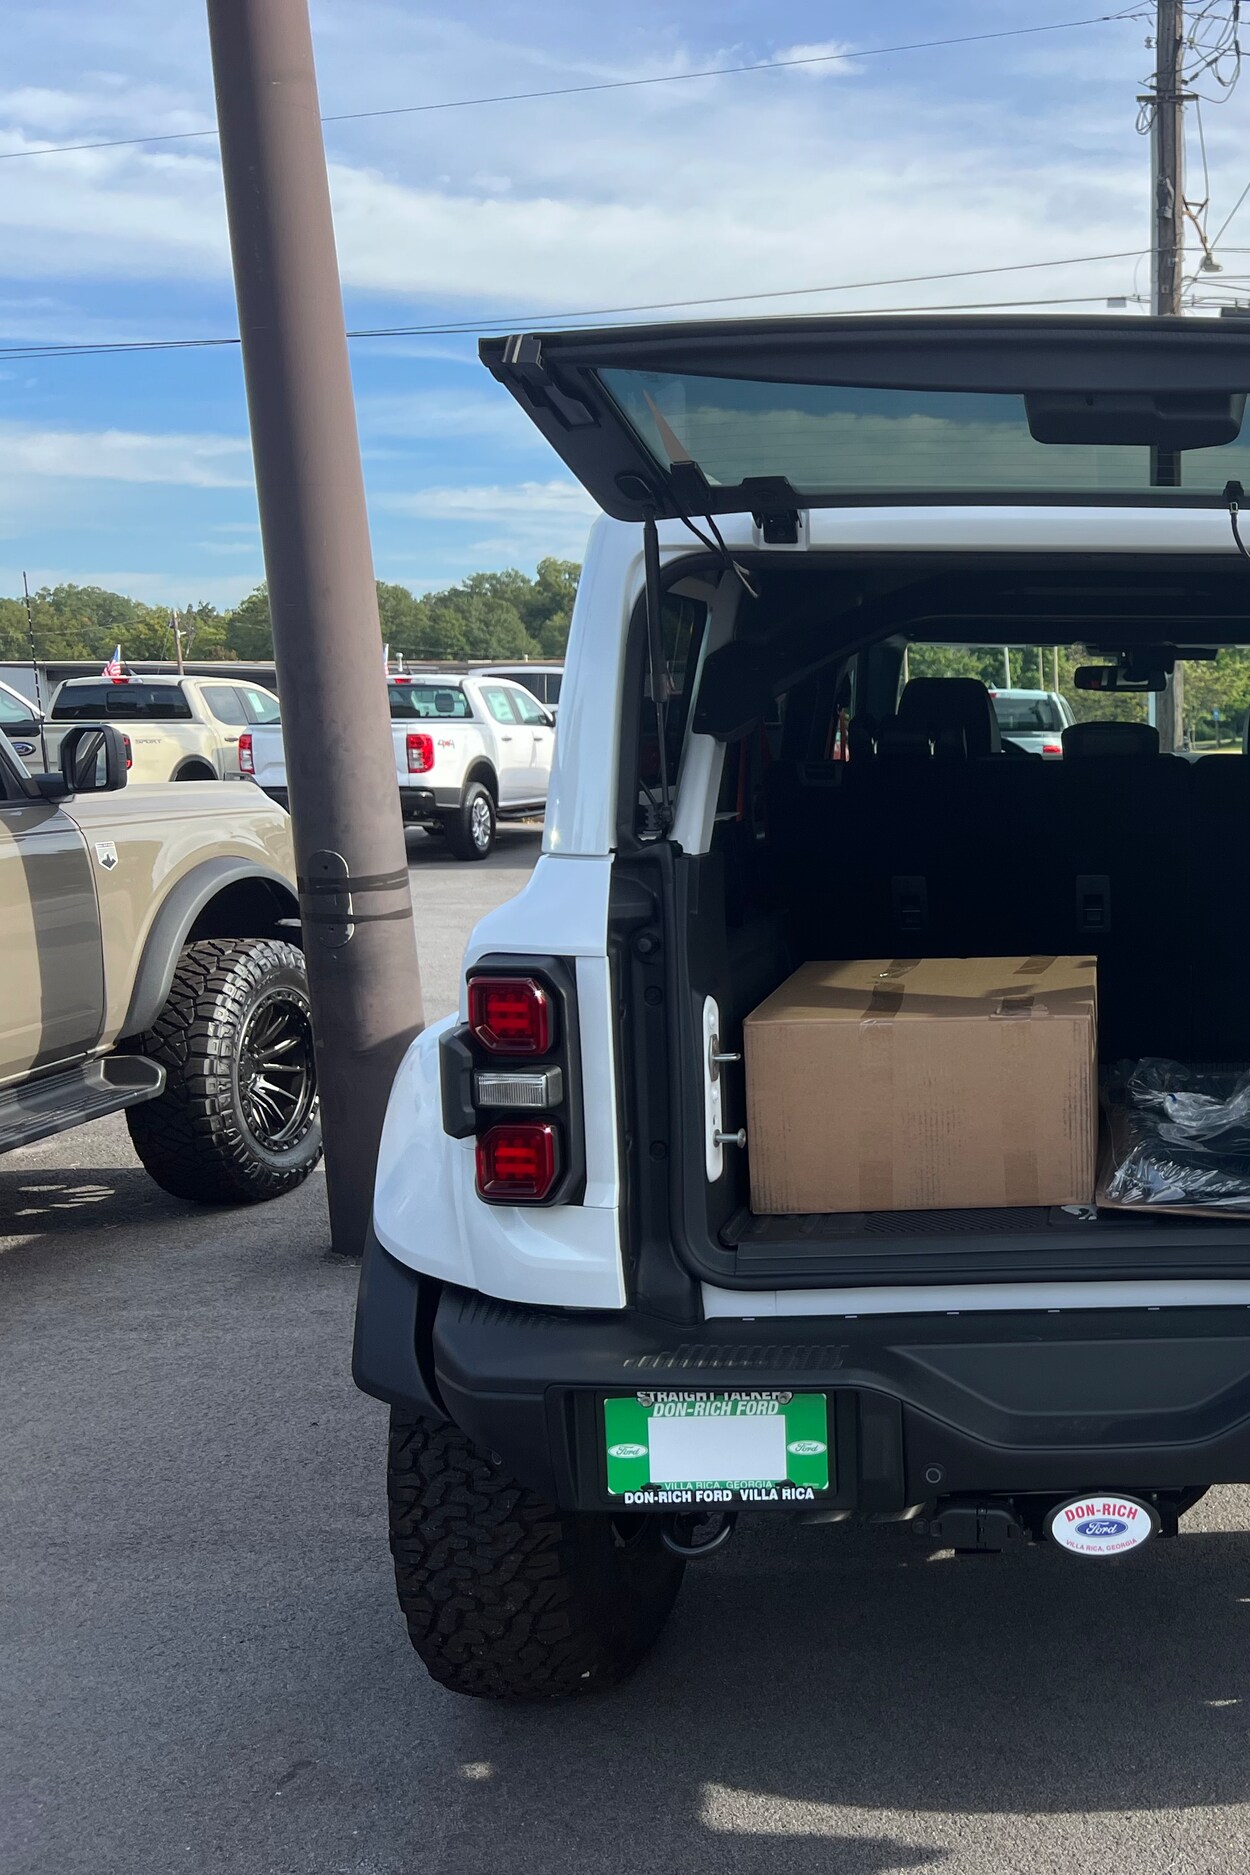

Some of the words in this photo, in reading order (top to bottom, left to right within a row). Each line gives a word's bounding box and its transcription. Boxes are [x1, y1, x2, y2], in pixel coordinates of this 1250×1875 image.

[653, 1401, 732, 1417] DON-RICH
[735, 1400, 779, 1416] FORD
[616, 1446, 640, 1456] Ford
[795, 1442, 819, 1452] Ford
[664, 1481, 693, 1490] VILLA
[725, 1480, 773, 1489] GEORGIA
[624, 1490, 692, 1504] DON-RICH
[695, 1489, 733, 1503] FORD
[740, 1487, 779, 1501] VILLA
[781, 1487, 815, 1500] RICA
[1064, 1503, 1138, 1522] DON-RICH
[1085, 1521, 1118, 1535] Ford
[1066, 1539, 1085, 1551] VILLA
[1106, 1538, 1138, 1552] GEORGIA
